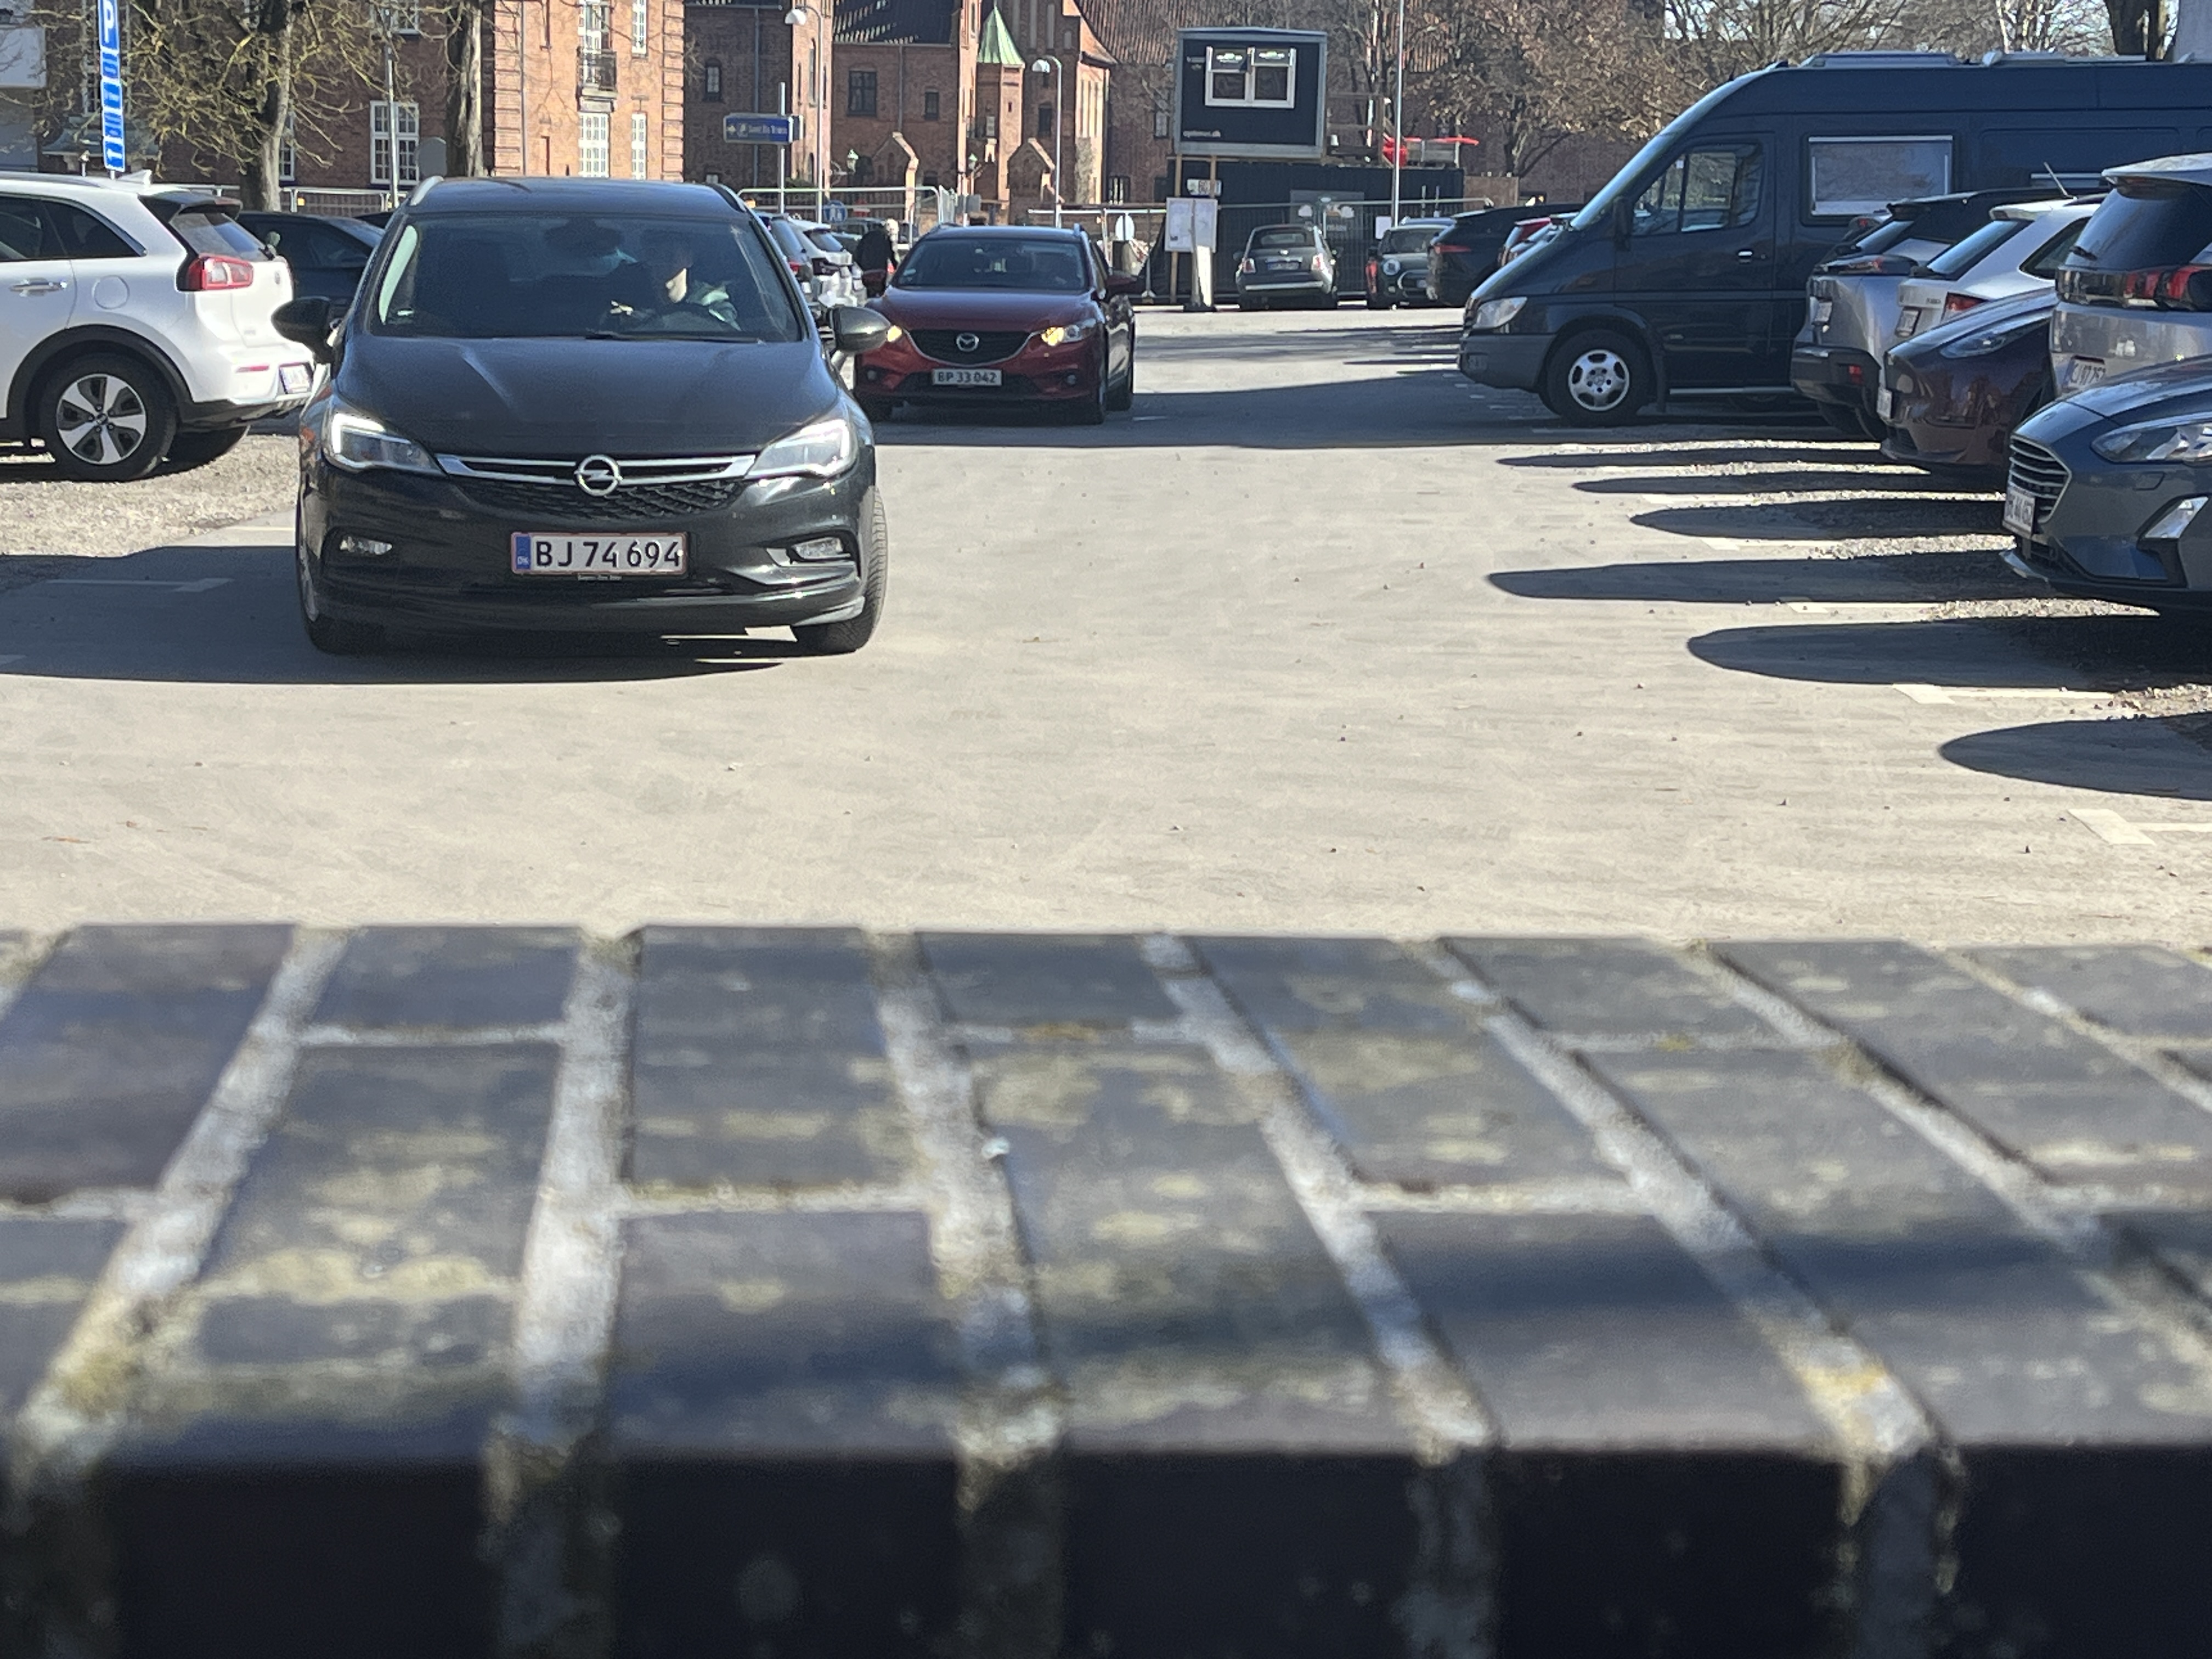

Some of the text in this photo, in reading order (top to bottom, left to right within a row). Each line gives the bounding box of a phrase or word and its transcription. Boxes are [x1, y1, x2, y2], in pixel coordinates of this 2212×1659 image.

[103, 1, 114, 43] P
[938, 371, 997, 383] BP 33 042
[535, 539, 680, 568] BJ 74 694
